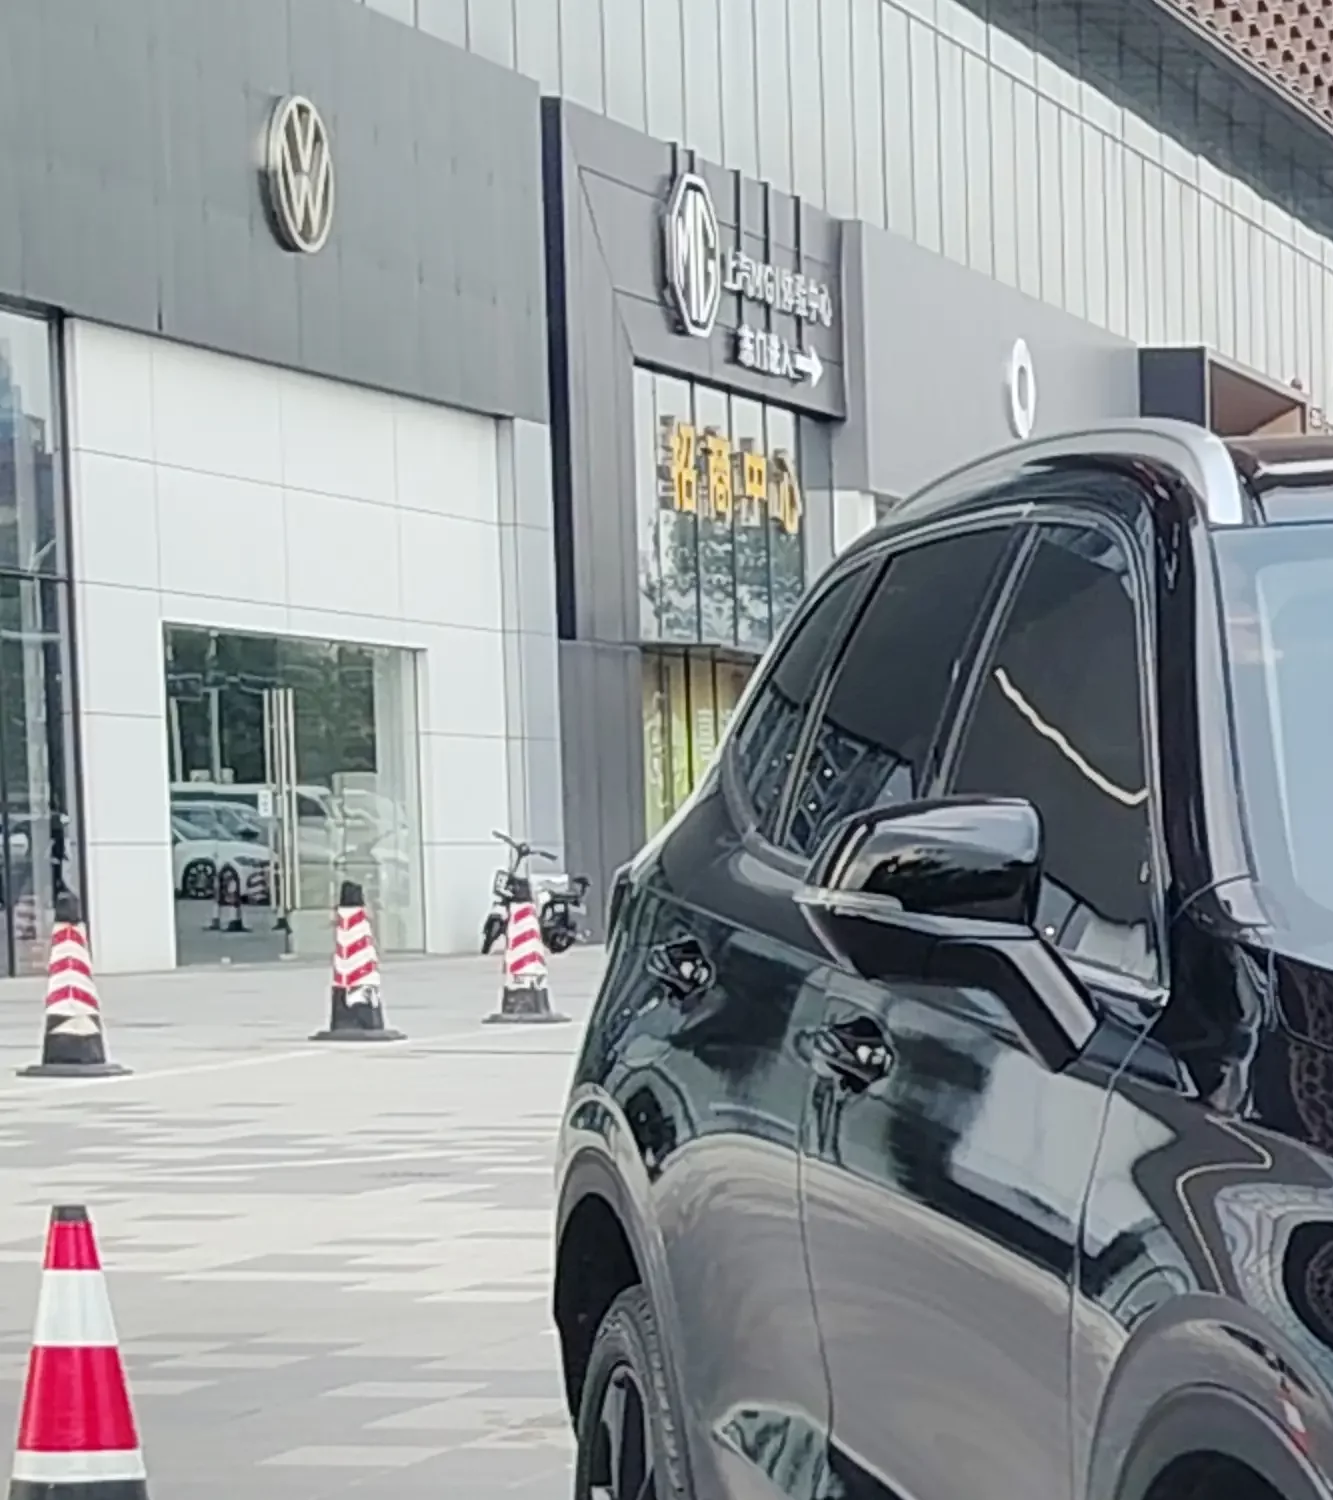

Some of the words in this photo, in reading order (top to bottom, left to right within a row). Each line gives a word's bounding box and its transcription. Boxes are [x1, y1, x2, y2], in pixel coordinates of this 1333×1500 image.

[672, 182, 719, 330] MG
[671, 422, 802, 534] 招商中心
